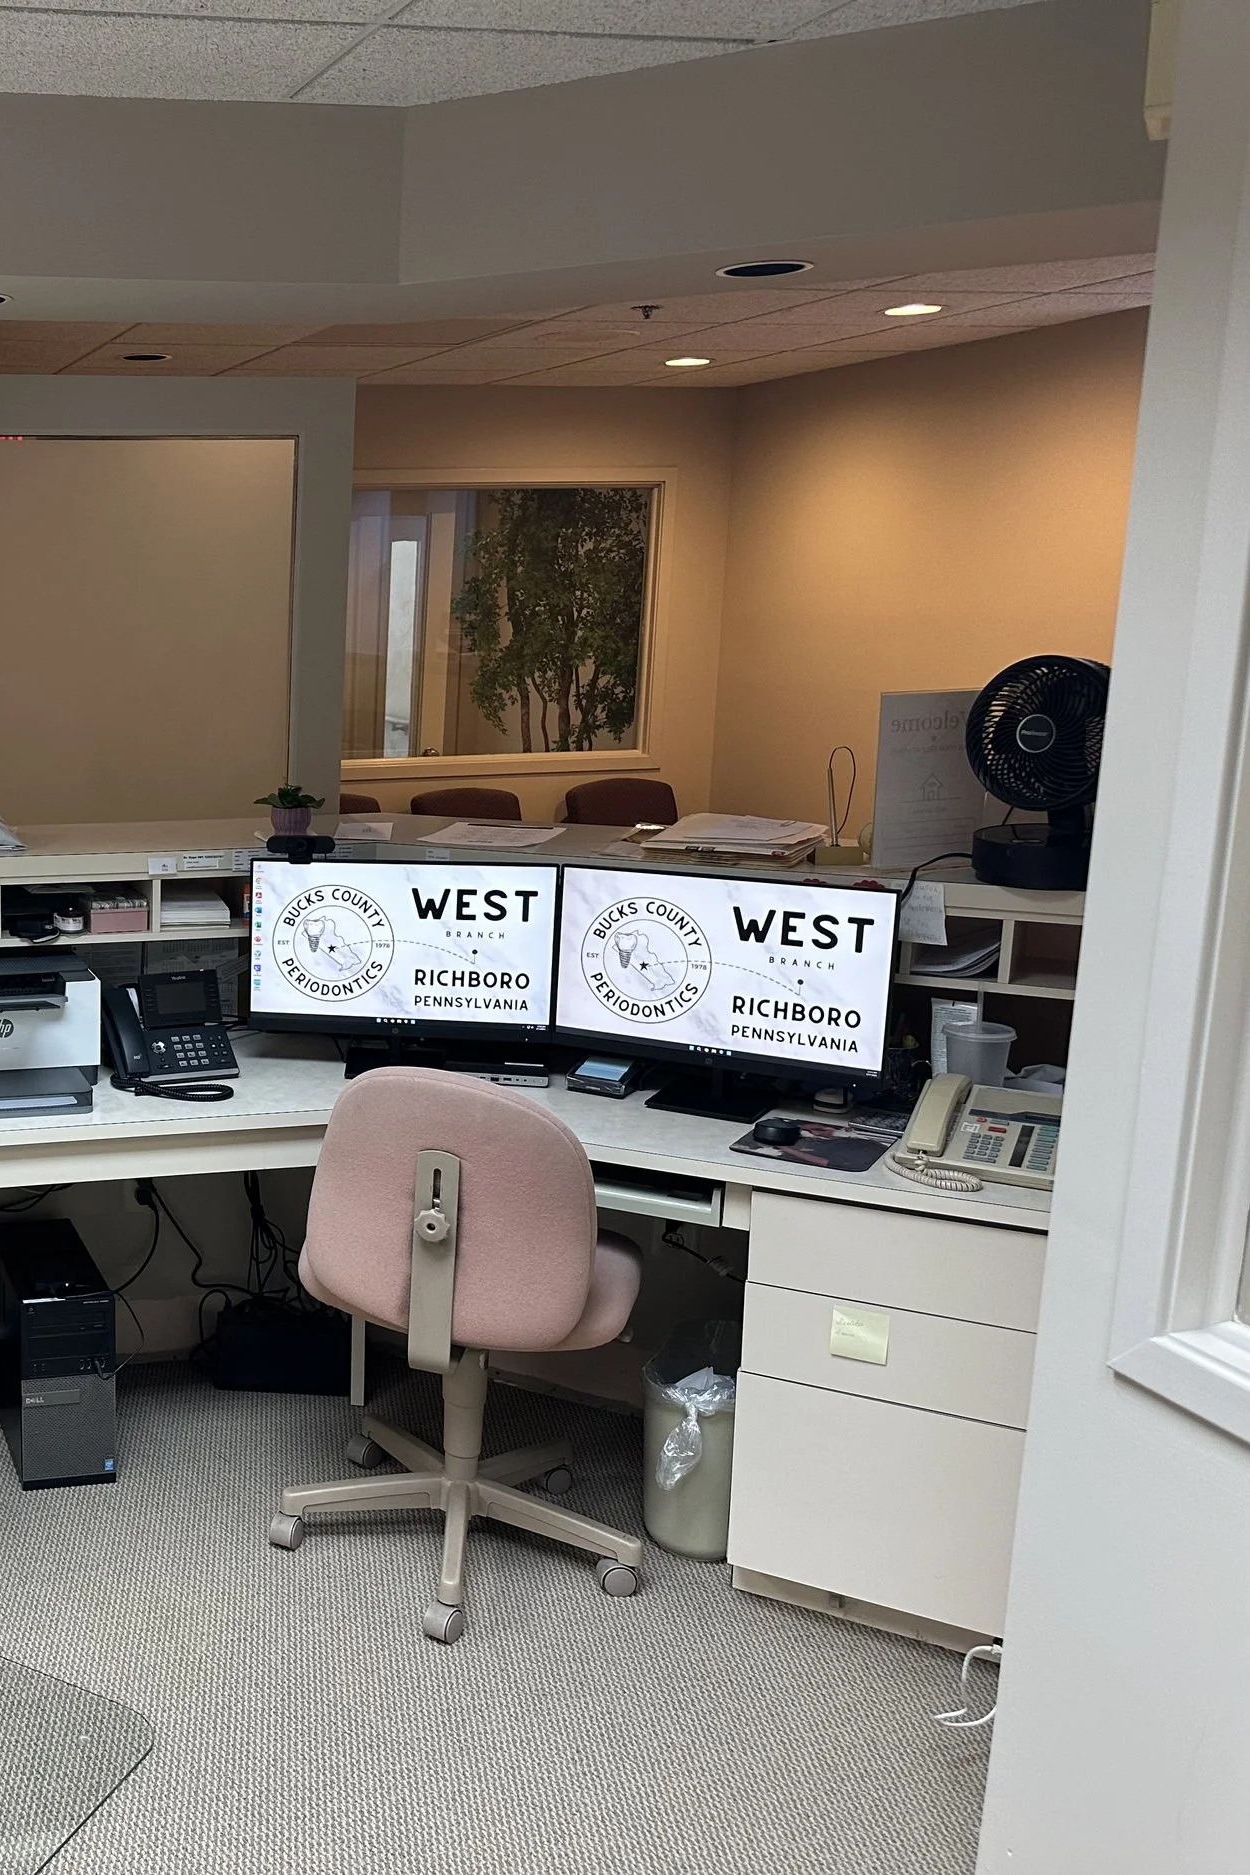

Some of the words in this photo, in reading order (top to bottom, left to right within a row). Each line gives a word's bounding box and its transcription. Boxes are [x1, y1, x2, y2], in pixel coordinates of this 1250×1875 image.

[283, 890, 325, 927] BUCKS
[332, 888, 385, 929] COUNTY
[411, 887, 539, 923] WEST
[446, 930, 505, 940] BRANCH
[593, 902, 639, 940] BUCKS
[645, 901, 702, 949] COUNTY
[732, 906, 875, 953] WEST
[282, 957, 383, 997] PERIODONTICS
[414, 969, 530, 990] RICHBORO
[769, 956, 835, 971] BRANCH
[414, 995, 529, 1011] PENNSYLVANIA
[590, 972, 699, 1018] PERIODONTICS
[732, 995, 862, 1029] RICHBORO
[731, 1024, 859, 1053] PENNSYLVANIA
[25, 1396, 45, 1404] DELL
